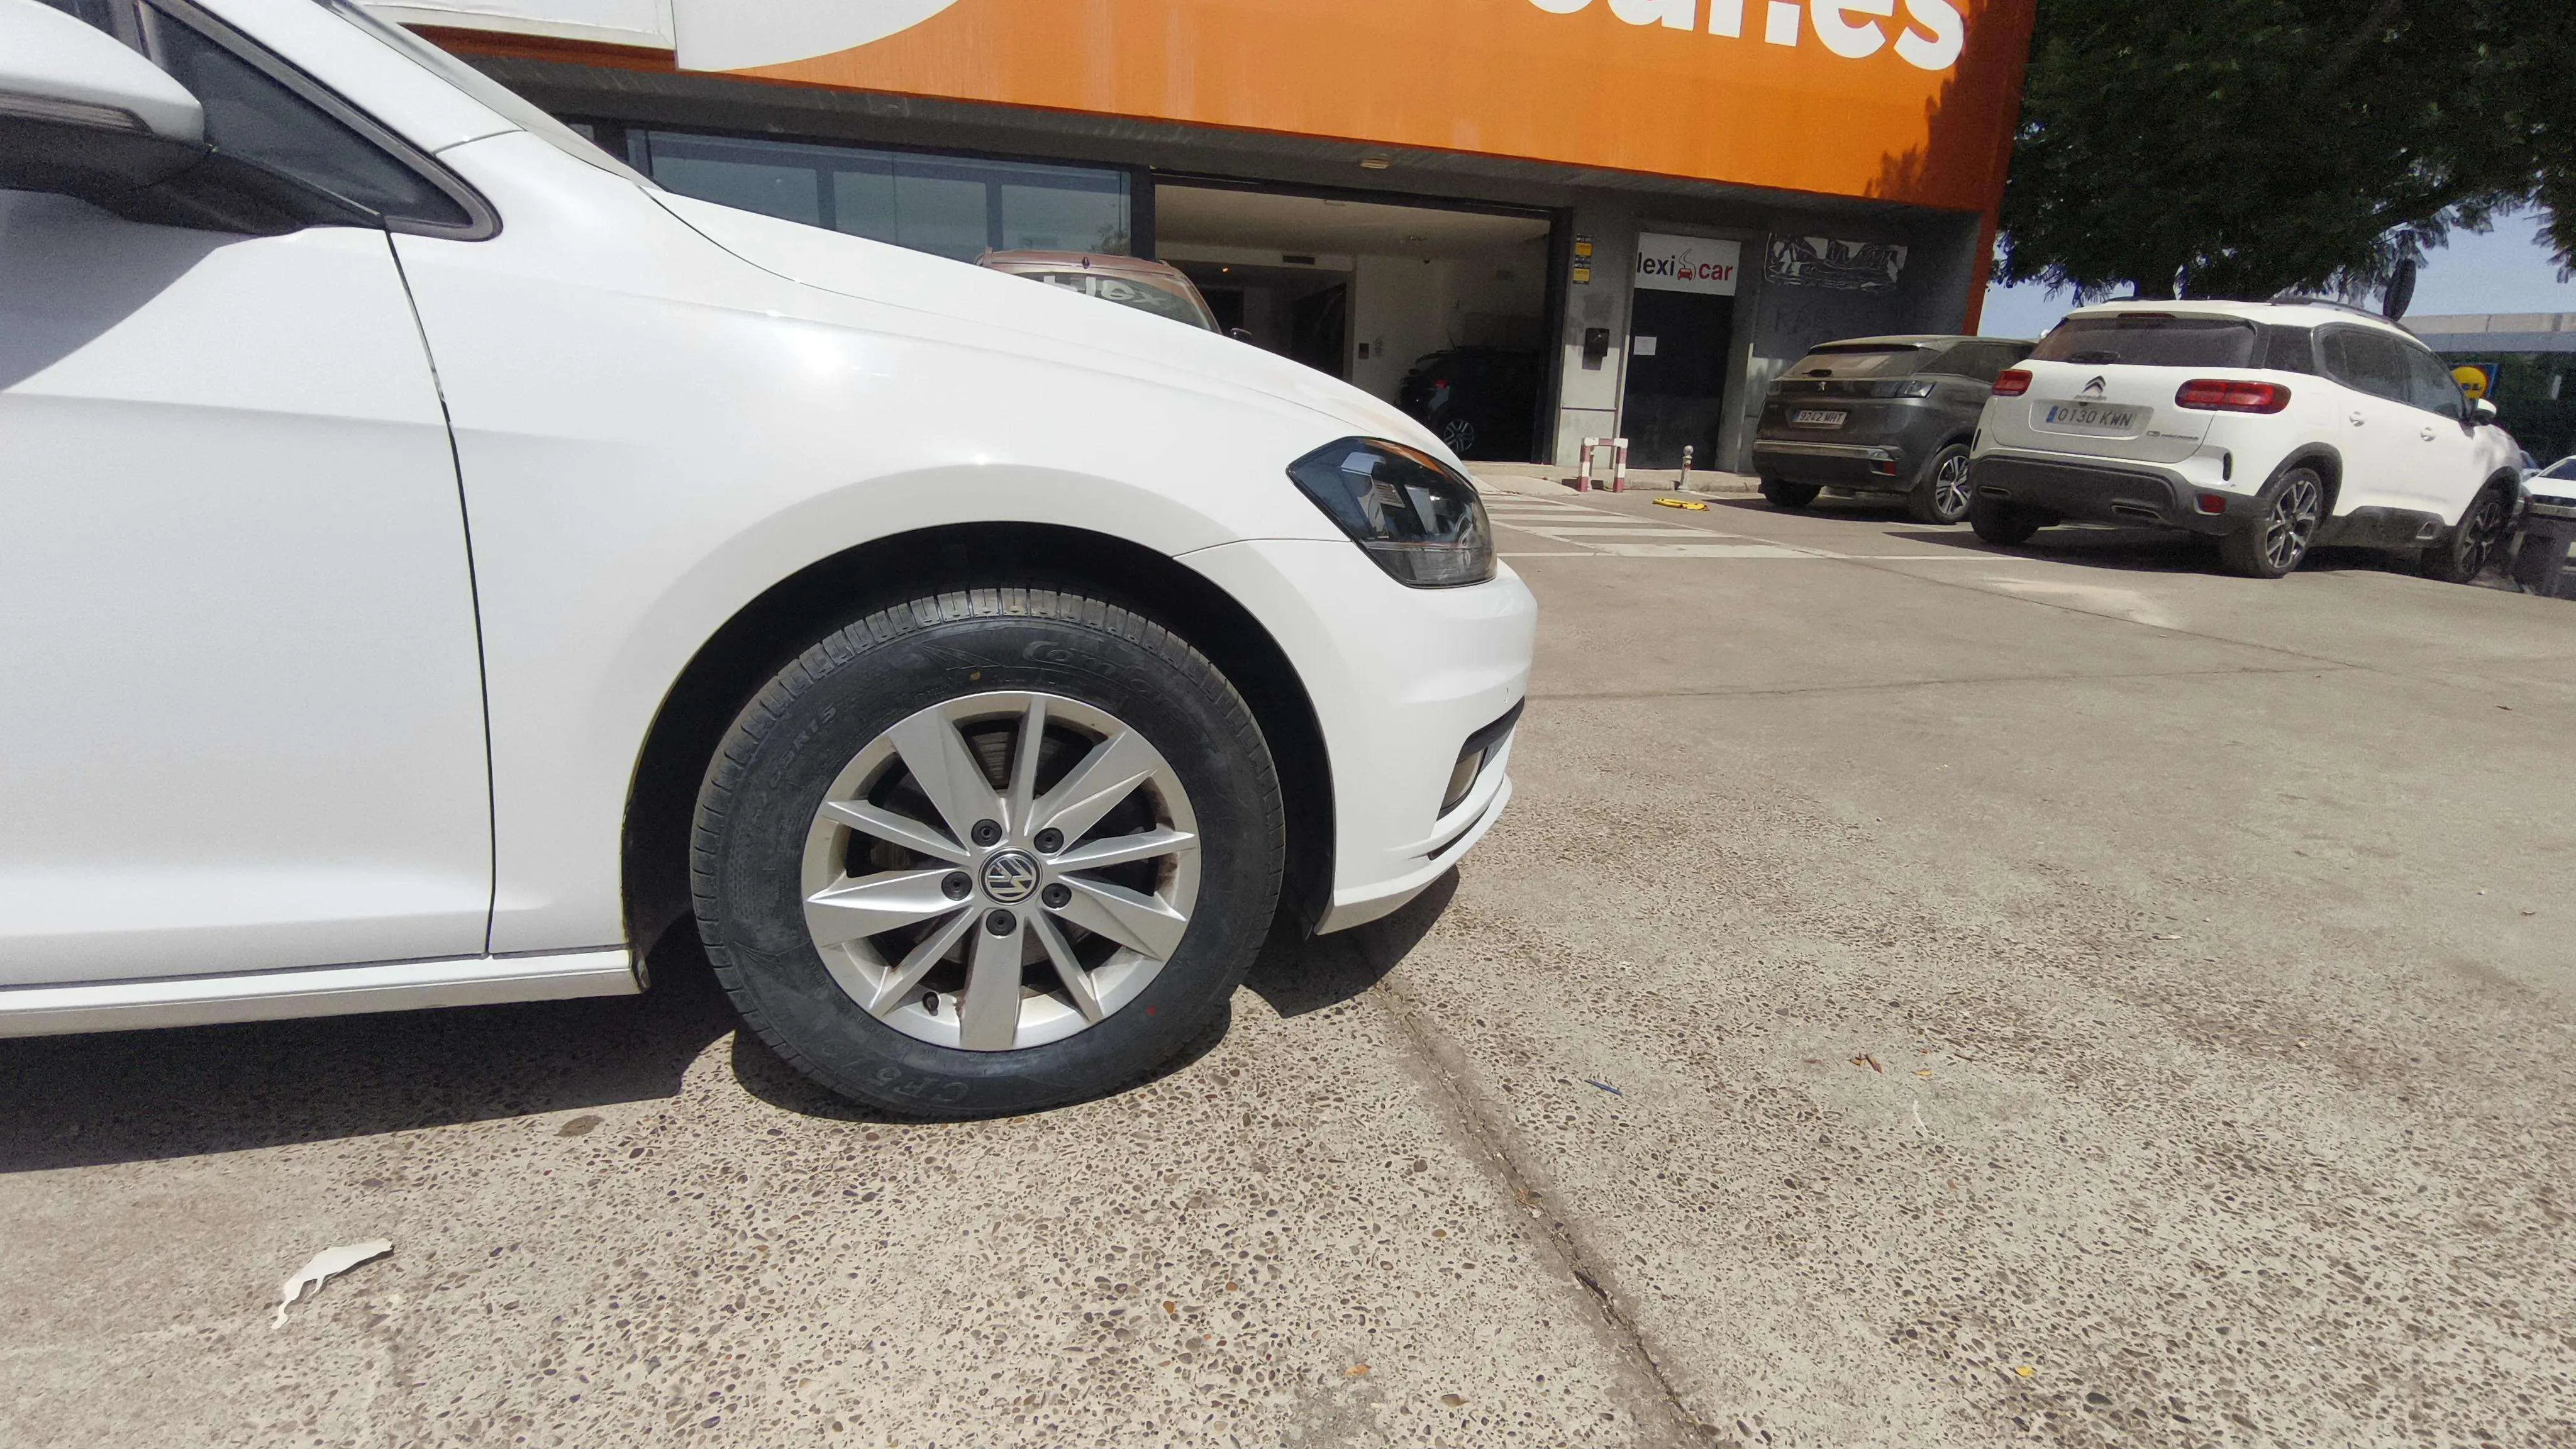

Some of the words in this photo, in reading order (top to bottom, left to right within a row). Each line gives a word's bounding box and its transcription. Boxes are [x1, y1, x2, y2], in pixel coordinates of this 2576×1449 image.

[1636, 252, 1675, 276] lexi
[1699, 263, 1734, 281] car
[2057, 408, 2098, 424] 0130
[2099, 409, 2133, 426] KWN
